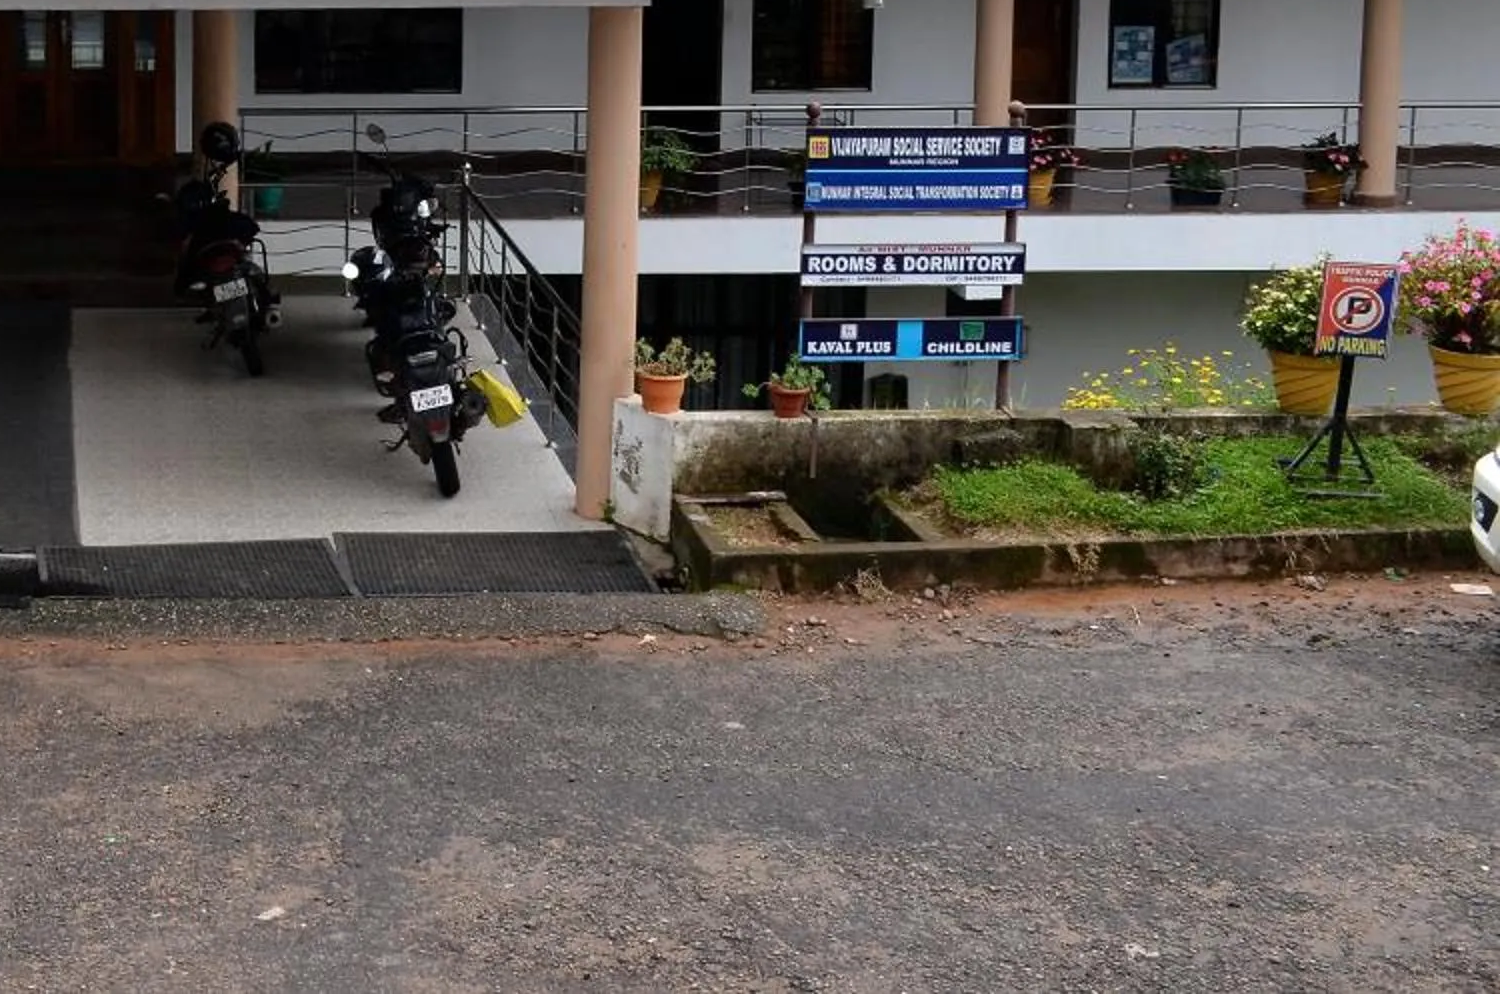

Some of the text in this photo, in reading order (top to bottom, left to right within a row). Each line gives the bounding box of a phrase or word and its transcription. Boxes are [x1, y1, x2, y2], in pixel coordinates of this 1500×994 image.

[832, 137, 891, 157] VIJAYAPURAM
[893, 137, 925, 157] SOCIAL
[926, 137, 964, 157] SERVICE
[965, 137, 1001, 156] SOCIETY
[855, 185, 887, 199] INTEGRAL
[889, 185, 914, 199] SOCIAL
[916, 185, 978, 199] TRANSFORMATION
[979, 185, 1009, 199] SOCIETY
[808, 255, 1016, 272] ROOMS & DORMITORY
[808, 341, 891, 354] KAVAL PLUS
[927, 342, 1012, 354] CHILDLINE
[1320, 335, 1385, 354] NO PARKING
